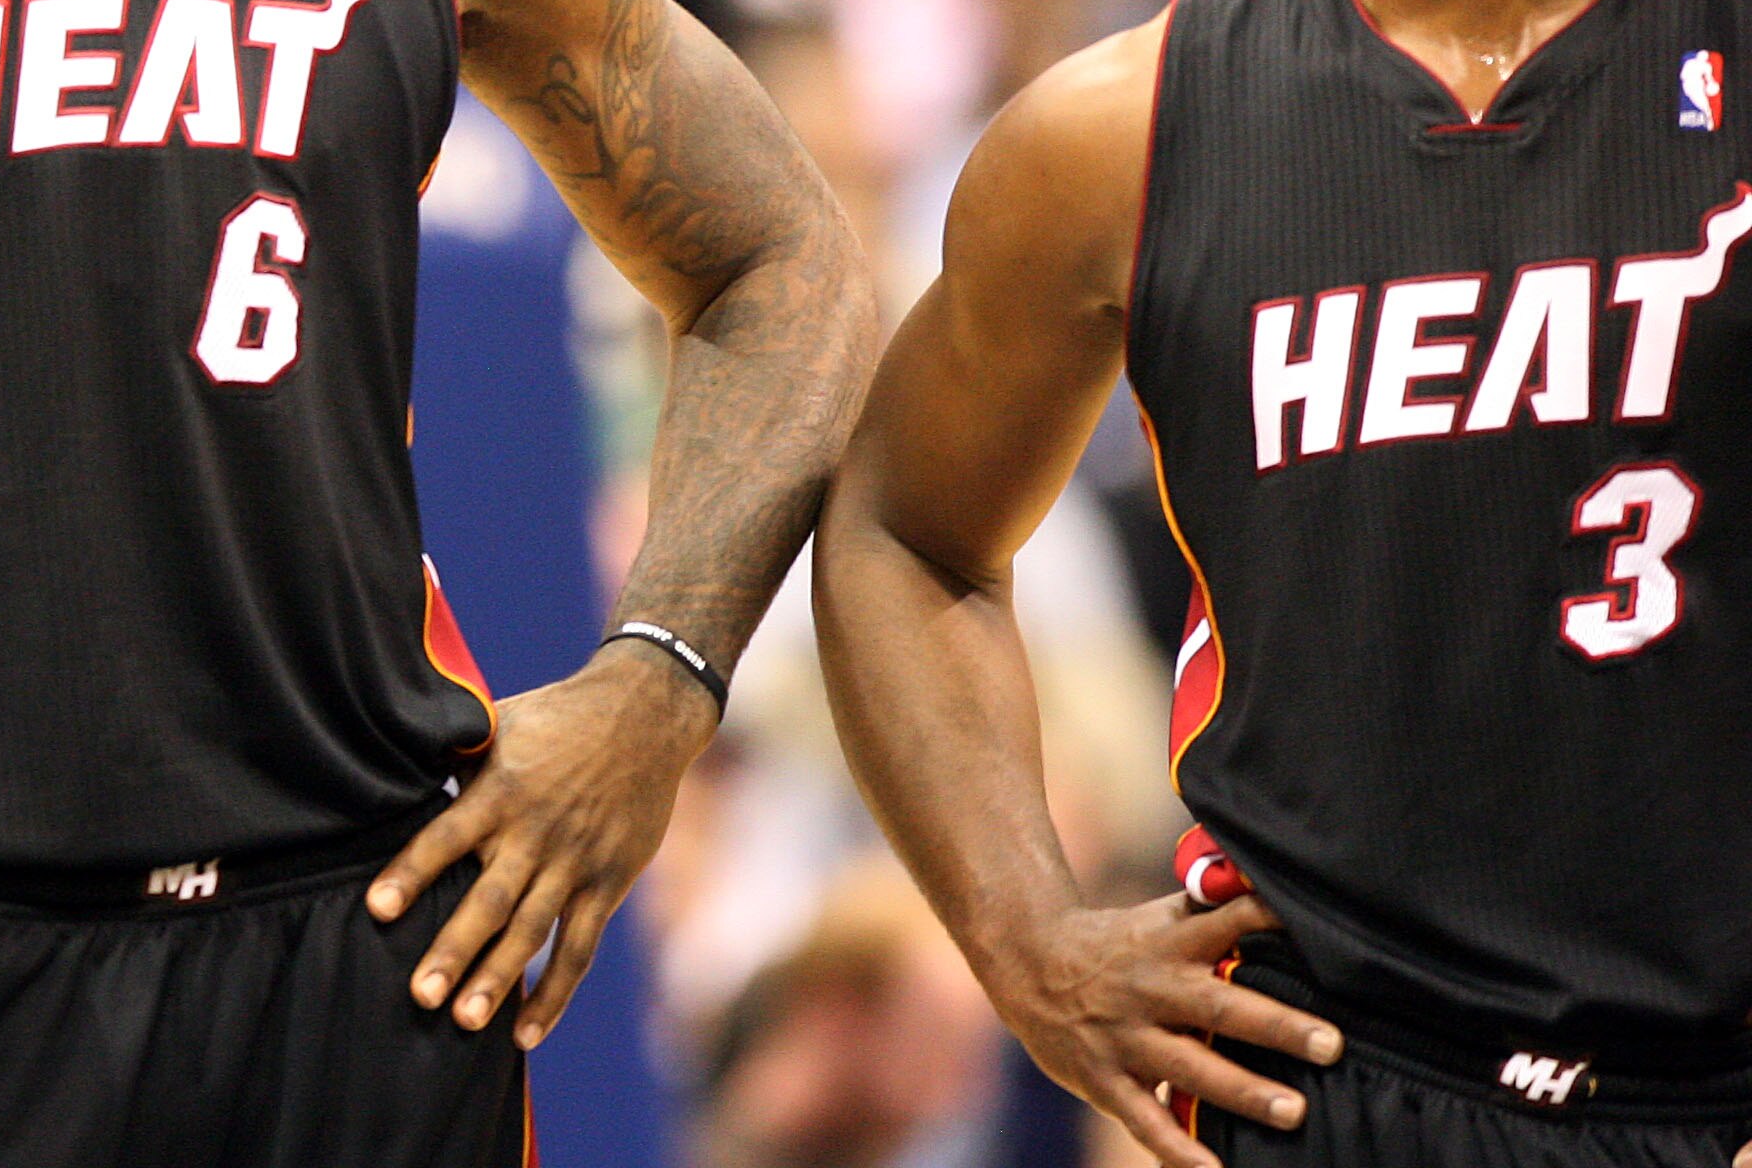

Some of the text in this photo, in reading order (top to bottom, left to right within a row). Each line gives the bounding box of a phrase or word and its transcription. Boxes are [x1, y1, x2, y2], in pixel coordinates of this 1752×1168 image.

[189, 189, 309, 385] 6
[1250, 180, 1752, 475] HEAT
[1560, 461, 1703, 662] 3
[146, 858, 221, 900] MH
[1499, 1051, 1591, 1105] MH
